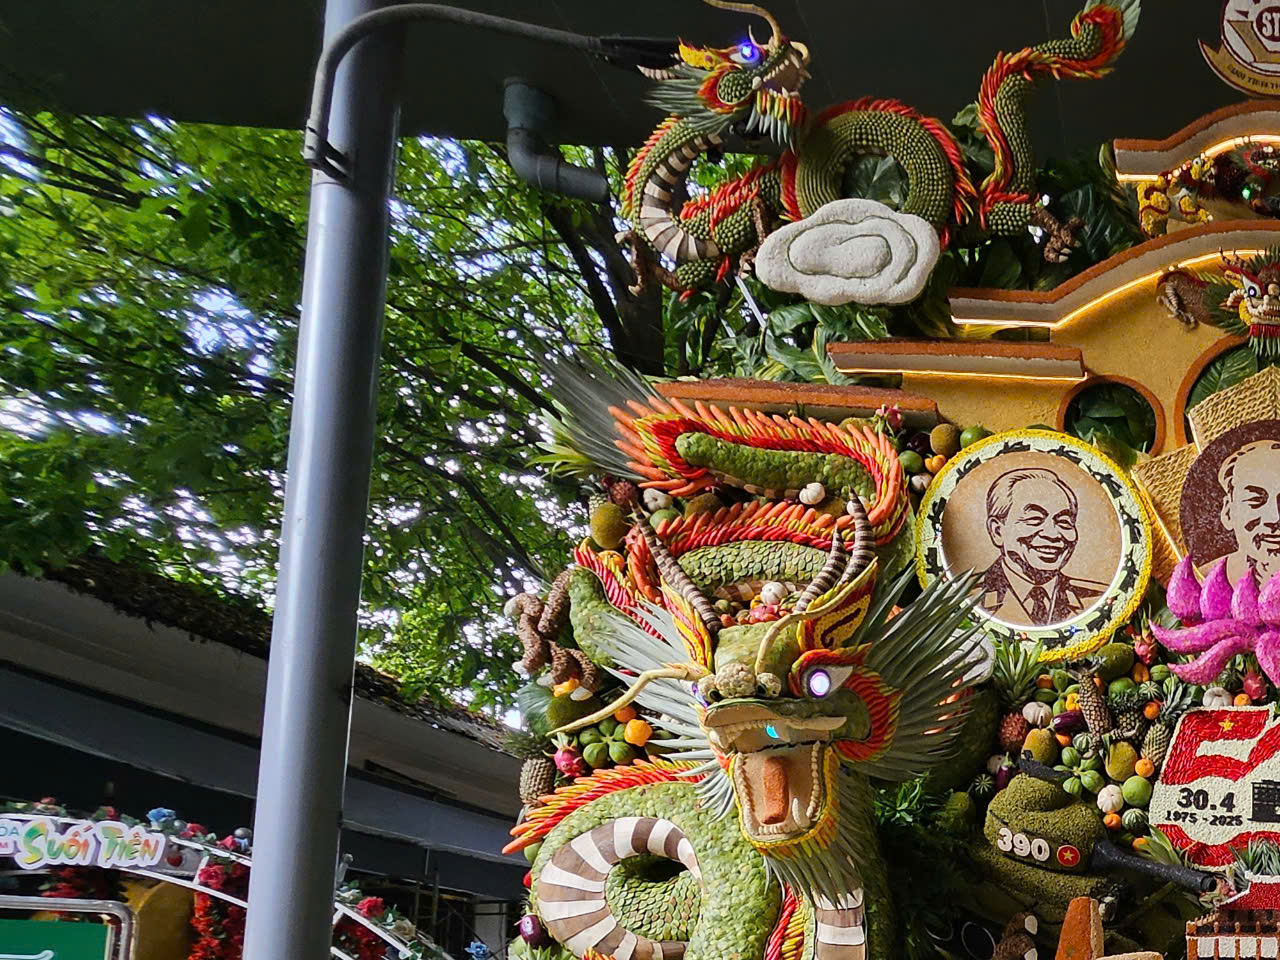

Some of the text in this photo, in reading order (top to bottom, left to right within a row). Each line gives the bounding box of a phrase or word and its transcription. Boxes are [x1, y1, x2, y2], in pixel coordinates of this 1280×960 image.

[1176, 787, 1236, 813] 30.4
[1165, 810, 1198, 825] 1975
[997, 827, 1050, 862] 390
